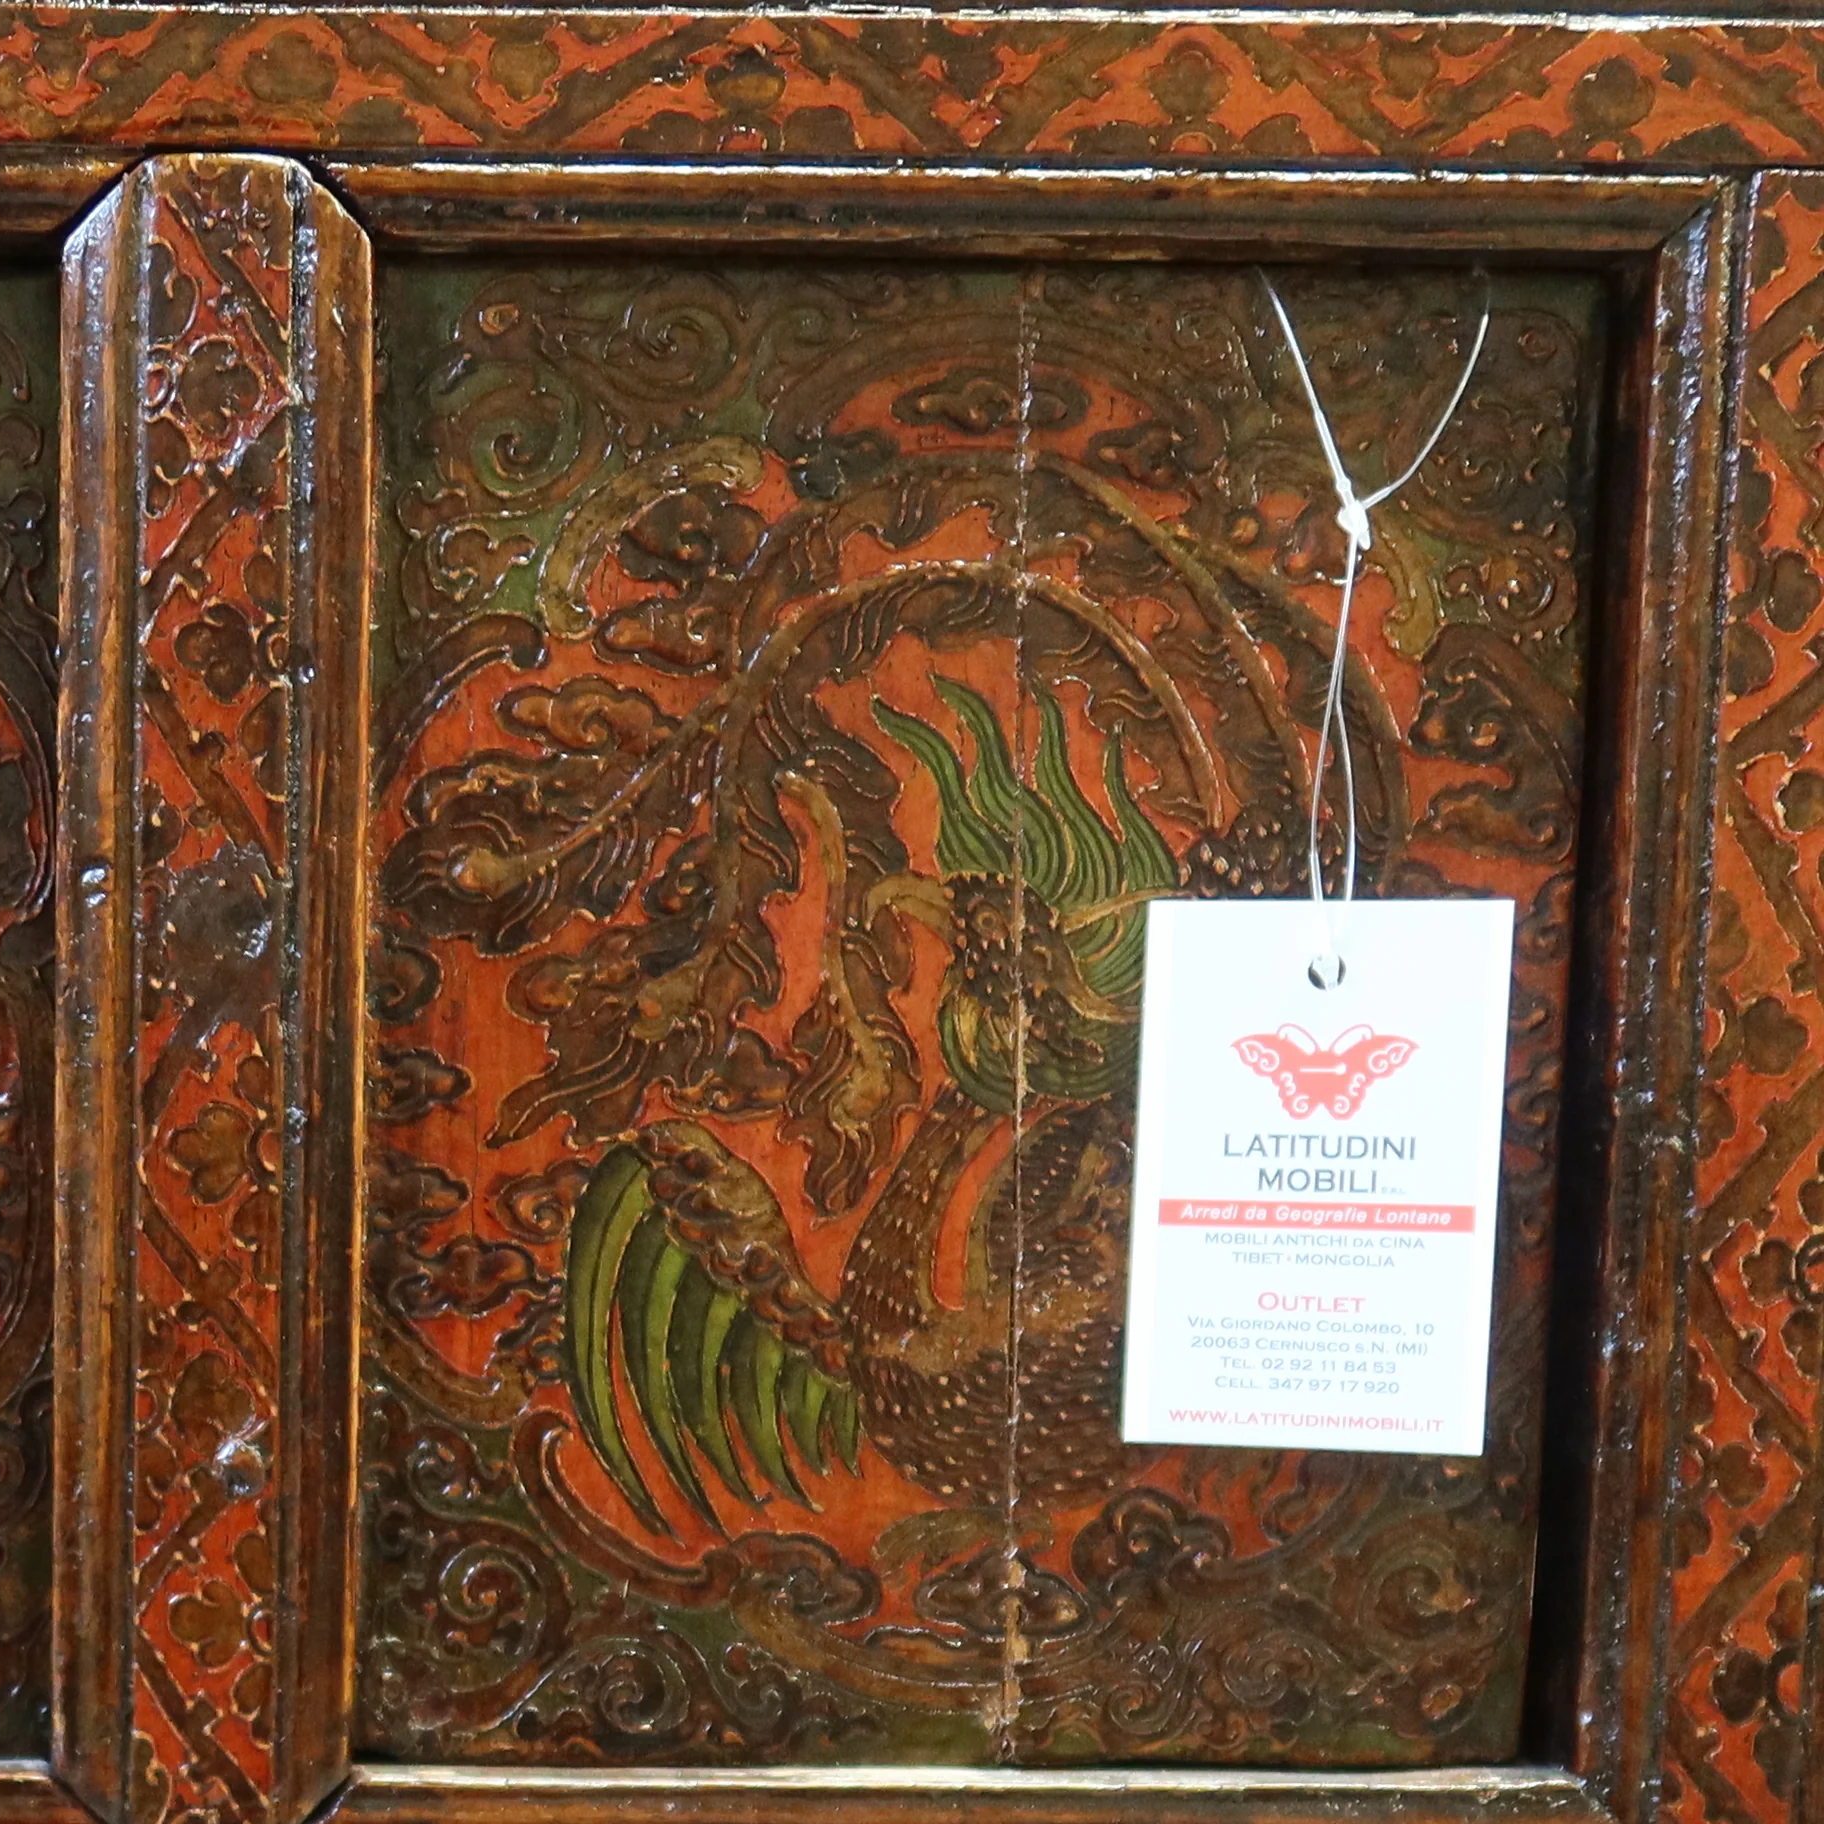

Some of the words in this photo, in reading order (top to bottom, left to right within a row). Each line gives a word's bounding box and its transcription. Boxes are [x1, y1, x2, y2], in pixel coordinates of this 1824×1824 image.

[1224, 1133, 1416, 1160] LATITUDINI
[1258, 1168, 1377, 1194] MOBILI
[1181, 1204, 1238, 1220] Arredi
[1245, 1206, 1267, 1221] da
[1276, 1206, 1367, 1226] Geografie
[1375, 1209, 1451, 1225] Lontane
[1205, 1232, 1268, 1246] MOBILI
[1274, 1234, 1348, 1248] ANTICHI
[1353, 1237, 1374, 1248] DA
[1380, 1237, 1425, 1249] CINA
[1232, 1252, 1283, 1265] TIBET
[1295, 1253, 1395, 1268] MONGOLIA
[1415, 1323, 1434, 1336] 10
[1190, 1336, 1250, 1349] 20063
[1395, 1341, 1428, 1356] (MI)
[1262, 1358, 1283, 1370] 02
[1289, 1358, 1313, 1372] 92
[1320, 1361, 1337, 1372] 11
[1344, 1360, 1367, 1373] 84
[1373, 1361, 1396, 1374] 53
[1268, 1378, 1302, 1391] 347
[1308, 1379, 1332, 1392] 97
[1339, 1381, 1359, 1393] 17
[1364, 1381, 1400, 1394] 920
